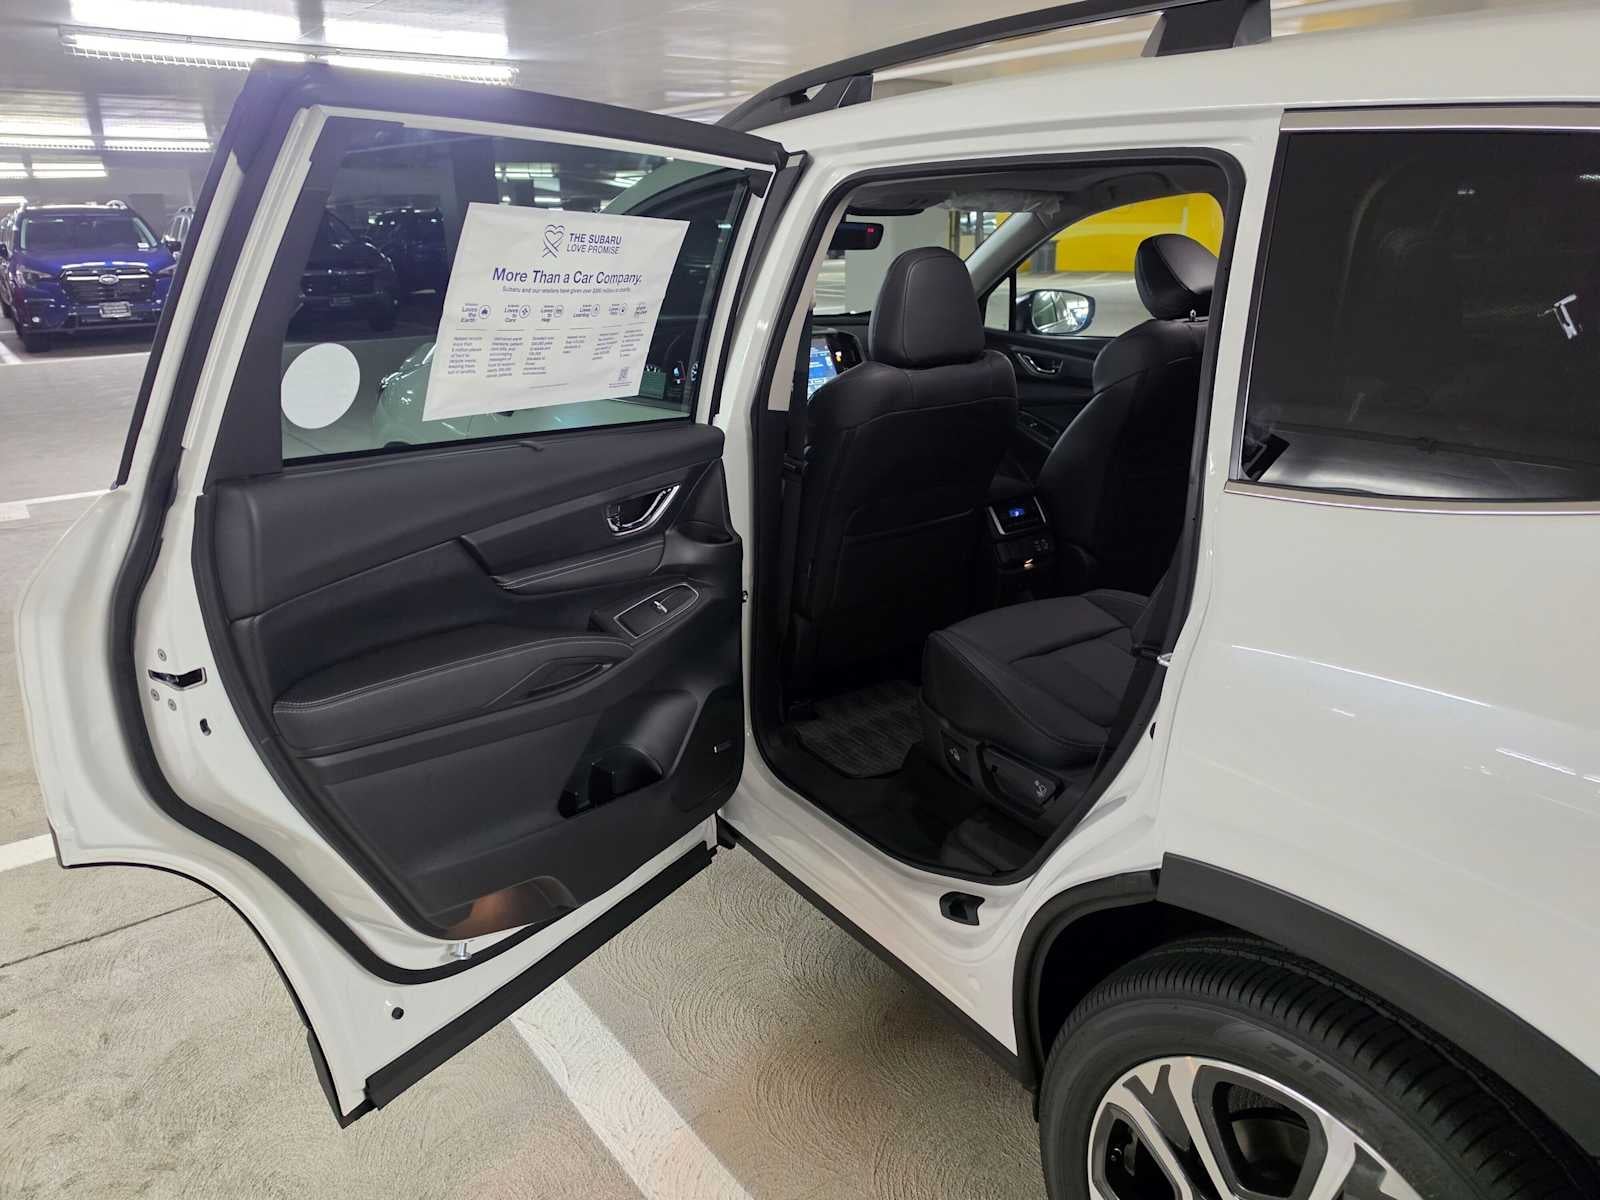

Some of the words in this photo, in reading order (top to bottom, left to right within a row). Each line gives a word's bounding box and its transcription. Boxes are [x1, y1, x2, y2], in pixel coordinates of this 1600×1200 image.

[569, 232, 586, 243] THE
[588, 234, 622, 245] SUBARU
[566, 243, 587, 253] LOVE
[587, 245, 620, 255] PROMISE
[492, 267, 528, 283] More
[532, 270, 561, 284] Than
[562, 273, 570, 284] a
[573, 270, 594, 284] Car
